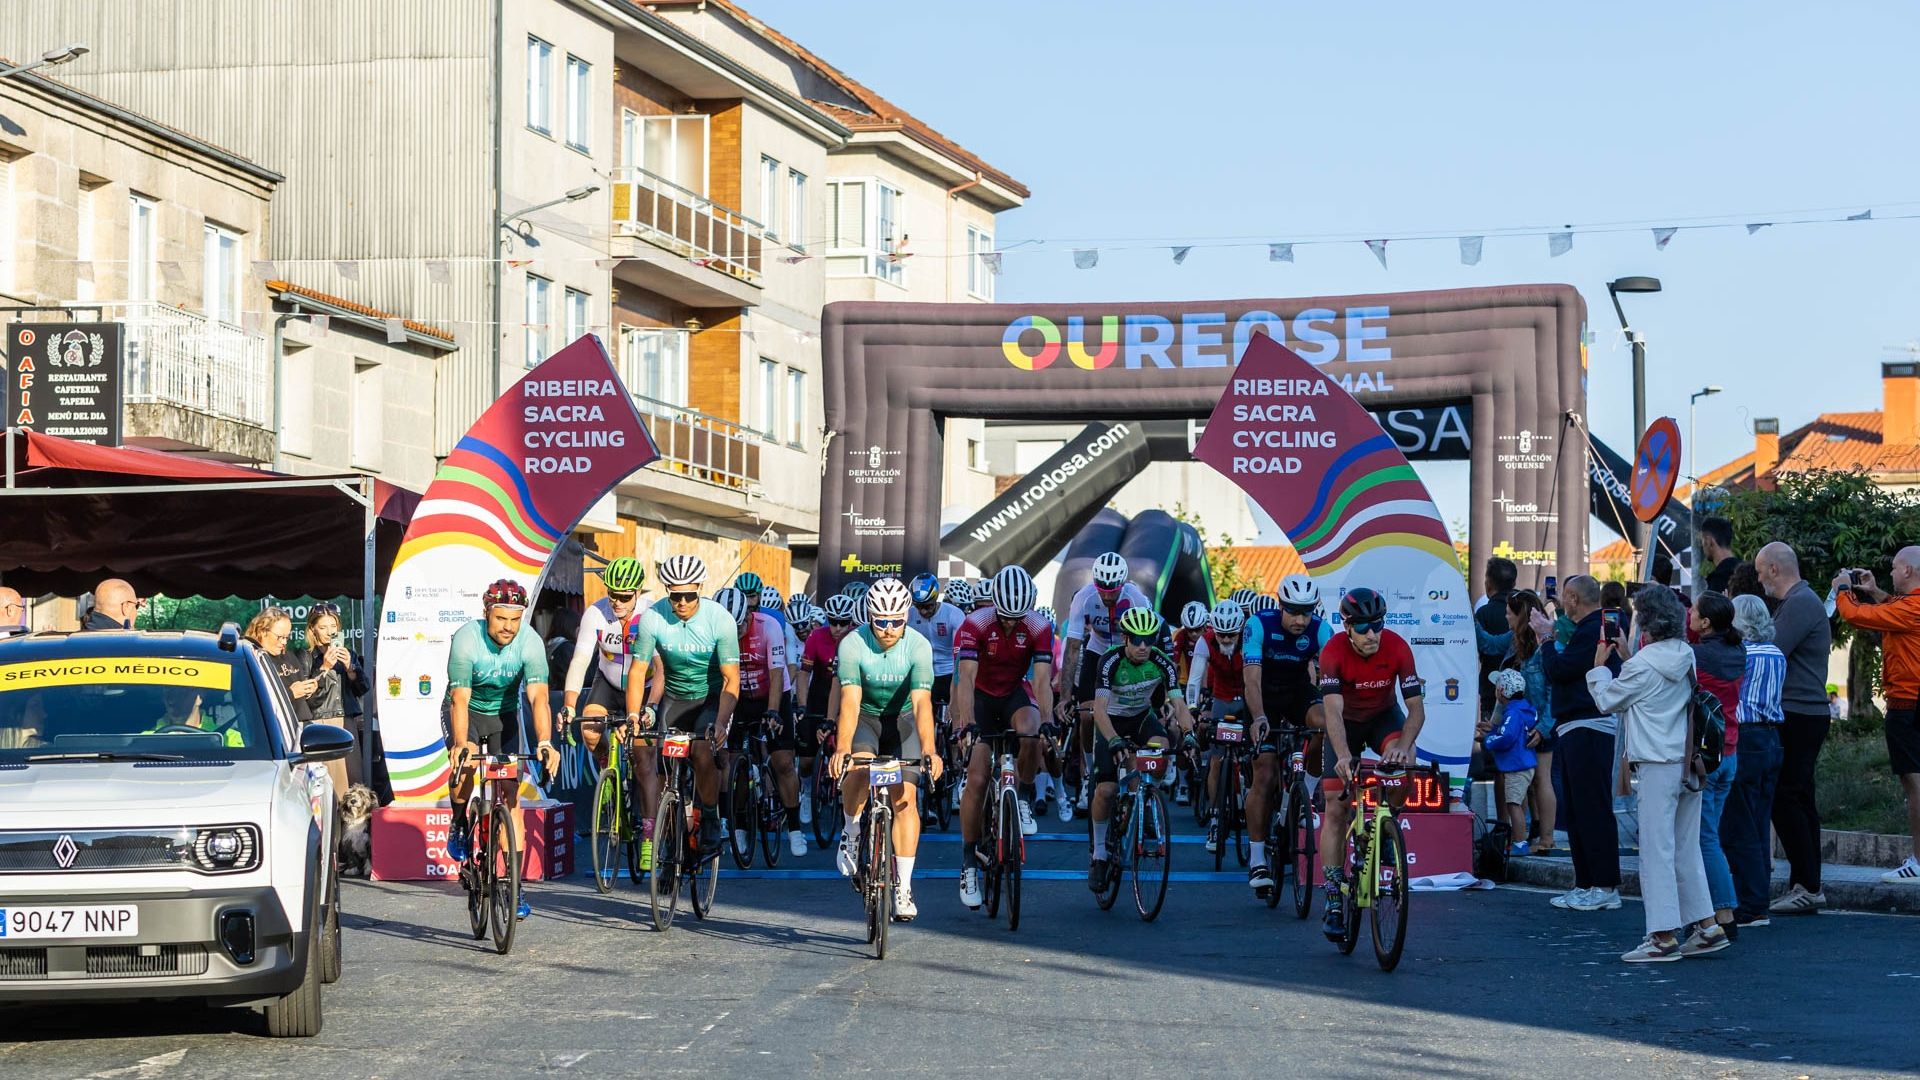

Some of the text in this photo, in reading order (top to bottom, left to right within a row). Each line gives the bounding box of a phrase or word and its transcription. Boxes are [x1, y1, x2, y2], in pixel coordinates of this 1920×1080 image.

[48, 373, 108, 382] RESTAURANTE
[54, 385, 101, 394] CAFETERIA
[524, 379, 618, 397] RIBEIRA
[1233, 379, 1329, 396] RIBEIRA
[17, 356, 36, 432] AFIA
[59, 397, 96, 406] TAPERIA
[73, 412, 90, 420] DEL
[524, 405, 605, 422] SACRA
[1233, 405, 1316, 422] SACRA
[524, 430, 625, 448] CYCLING
[1232, 431, 1337, 448] CYCLING
[1498, 454, 1552, 462] DEPUTACIÓN
[525, 456, 592, 473] ROAD
[1233, 456, 1302, 474] ROAD
[848, 468, 901, 477] DEPUTACIÓN
[970, 422, 1130, 543] www.rodosa.com
[1506, 502, 1538, 512] inorde
[854, 516, 886, 526] inorde
[1510, 551, 1557, 560] DEPORTE
[857, 564, 902, 572] DEPORTE
[1428, 590, 1449, 600] OU
[5, 663, 199, 681] SERVICIO MÉDICO
[1222, 732, 1237, 741] 153
[667, 746, 684, 756] 172
[1145, 760, 1157, 770] 10
[497, 768, 508, 777] 15
[876, 773, 897, 784] 275
[426, 864, 461, 876] ROA
[13, 910, 131, 932] 9047 NNP
